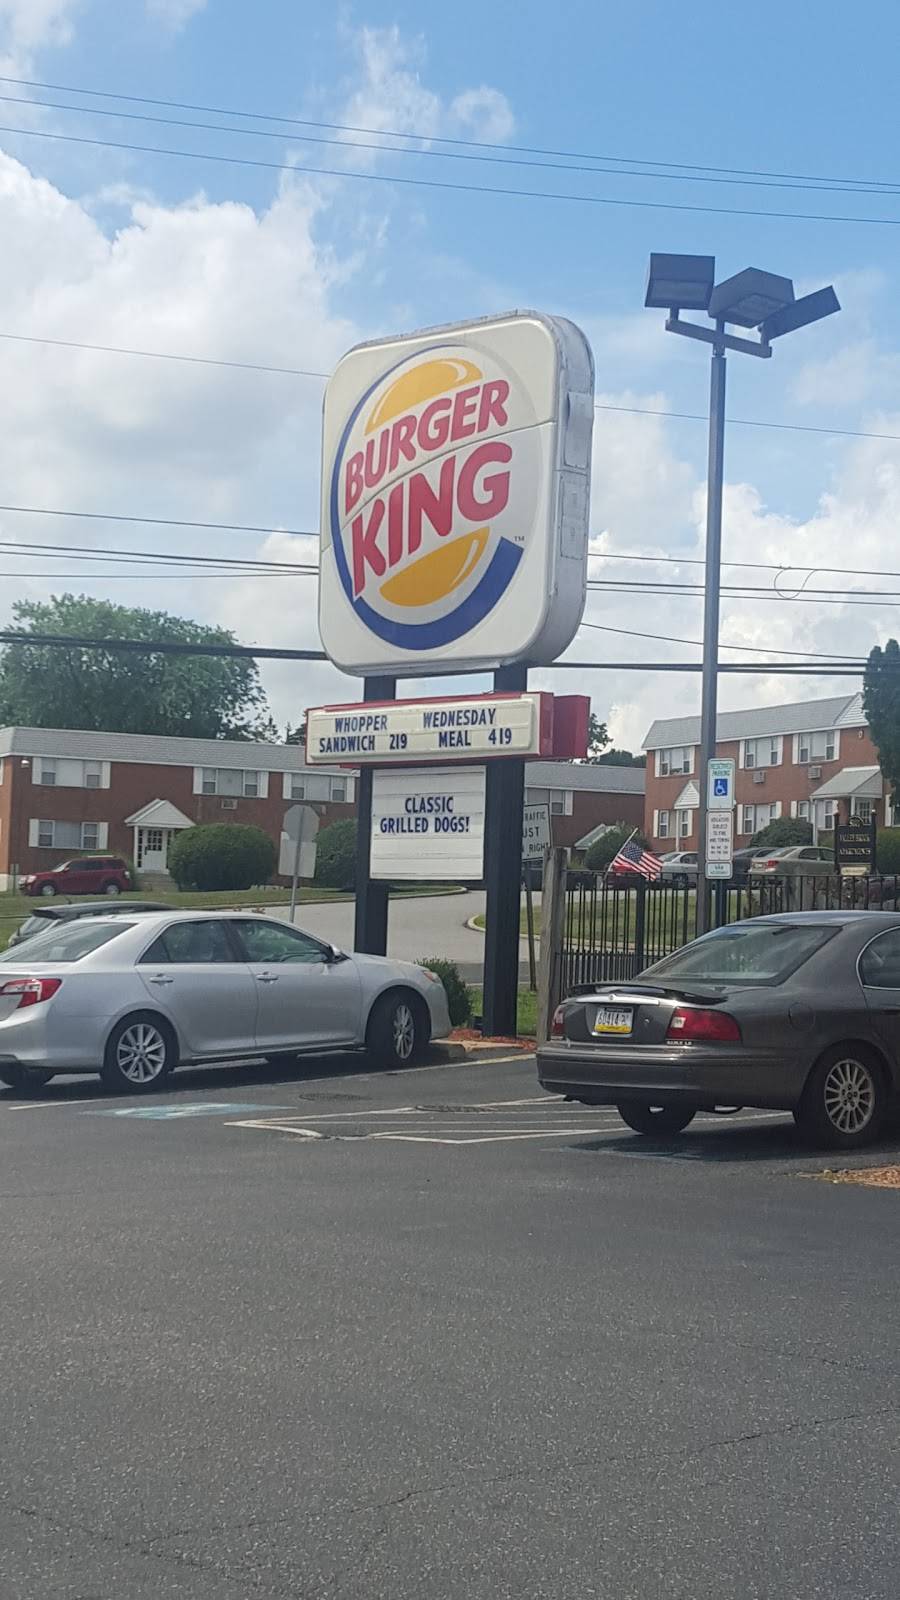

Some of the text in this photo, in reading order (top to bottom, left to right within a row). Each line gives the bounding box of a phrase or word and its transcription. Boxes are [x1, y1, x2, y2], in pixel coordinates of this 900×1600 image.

[345, 379, 510, 516] BURGER
[352, 442, 513, 597] KING
[335, 708, 496, 733] WHOPPER WEDNESDAY
[319, 727, 512, 753] SANDWICH 219 MEAL 419
[405, 796, 454, 813] CLASSIC
[380, 816, 470, 833] GRILLED DOGS!
[525, 811, 546, 821] RAFFIC
[523, 826, 540, 838] UST
